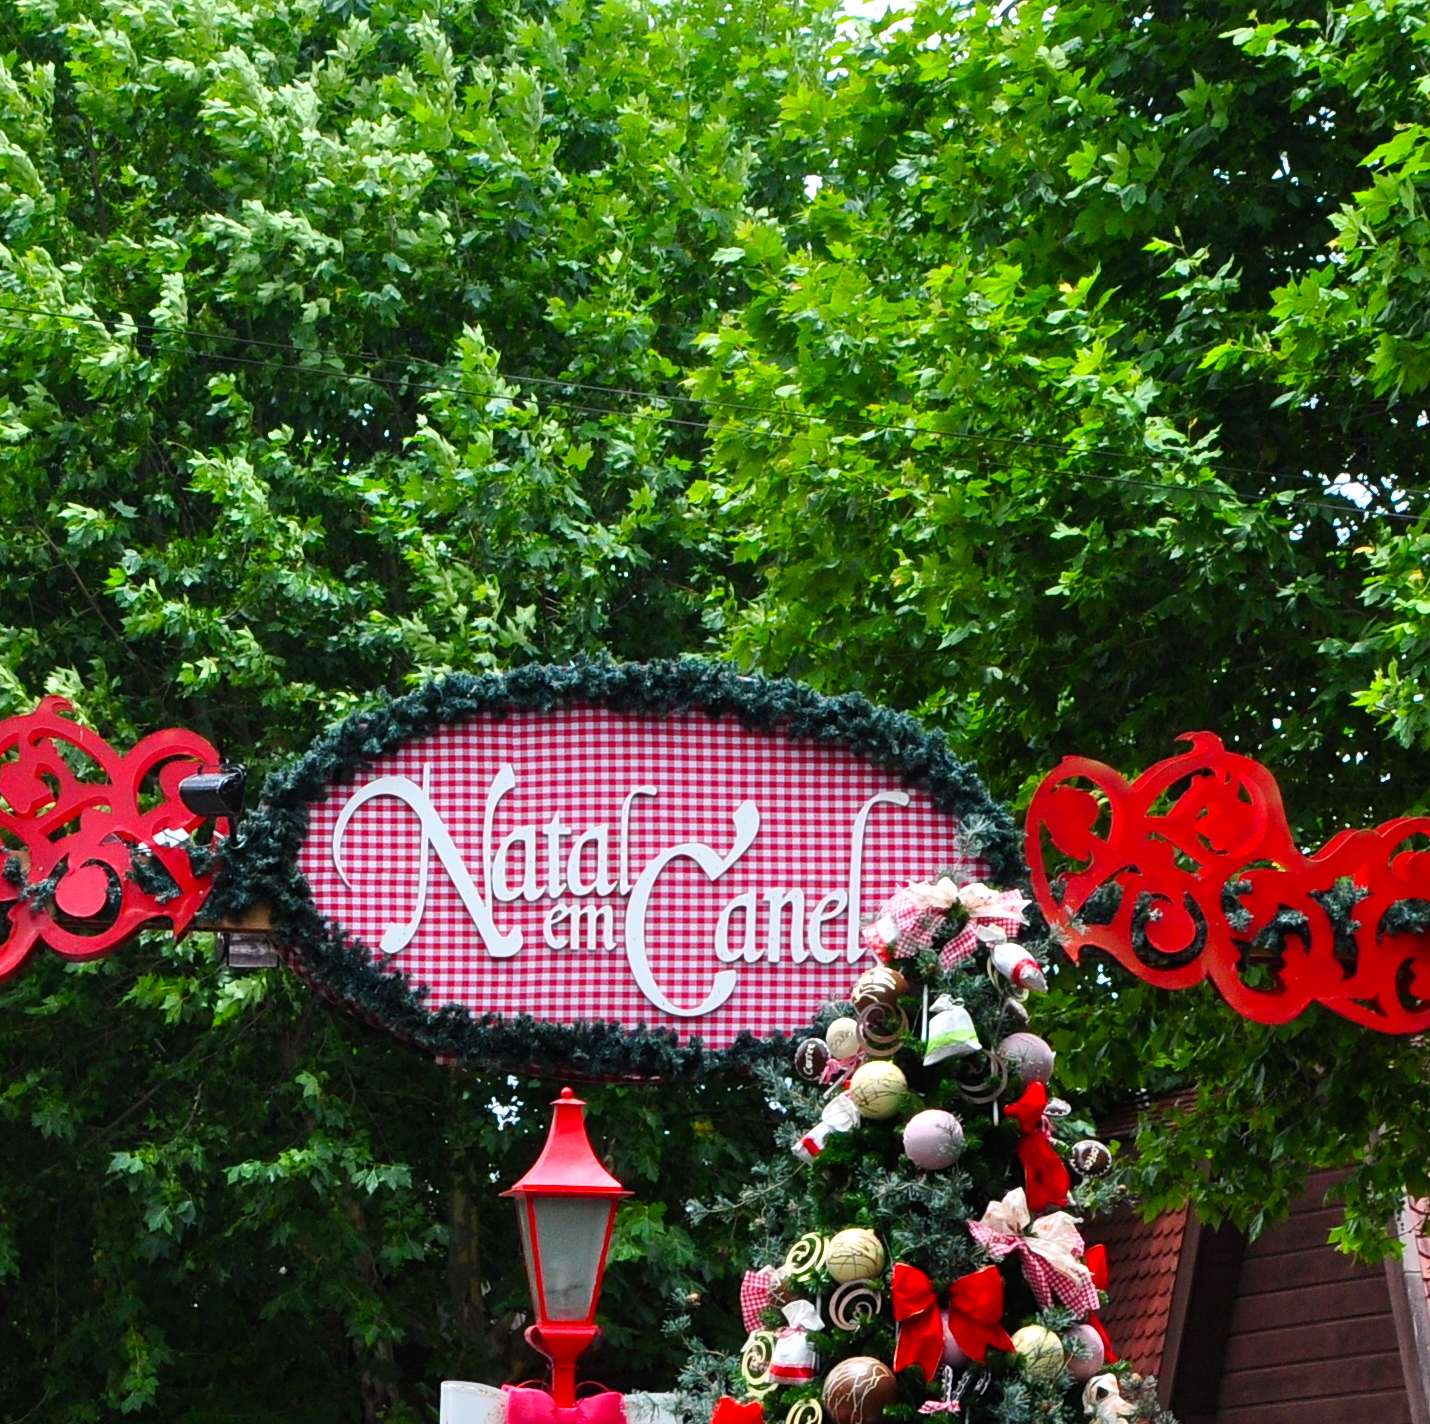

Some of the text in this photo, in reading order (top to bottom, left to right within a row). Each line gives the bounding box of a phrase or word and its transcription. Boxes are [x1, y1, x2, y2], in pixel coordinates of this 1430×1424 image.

[332, 762, 658, 959] Natal
[542, 897, 618, 954] em
[624, 790, 909, 1018] Canel
